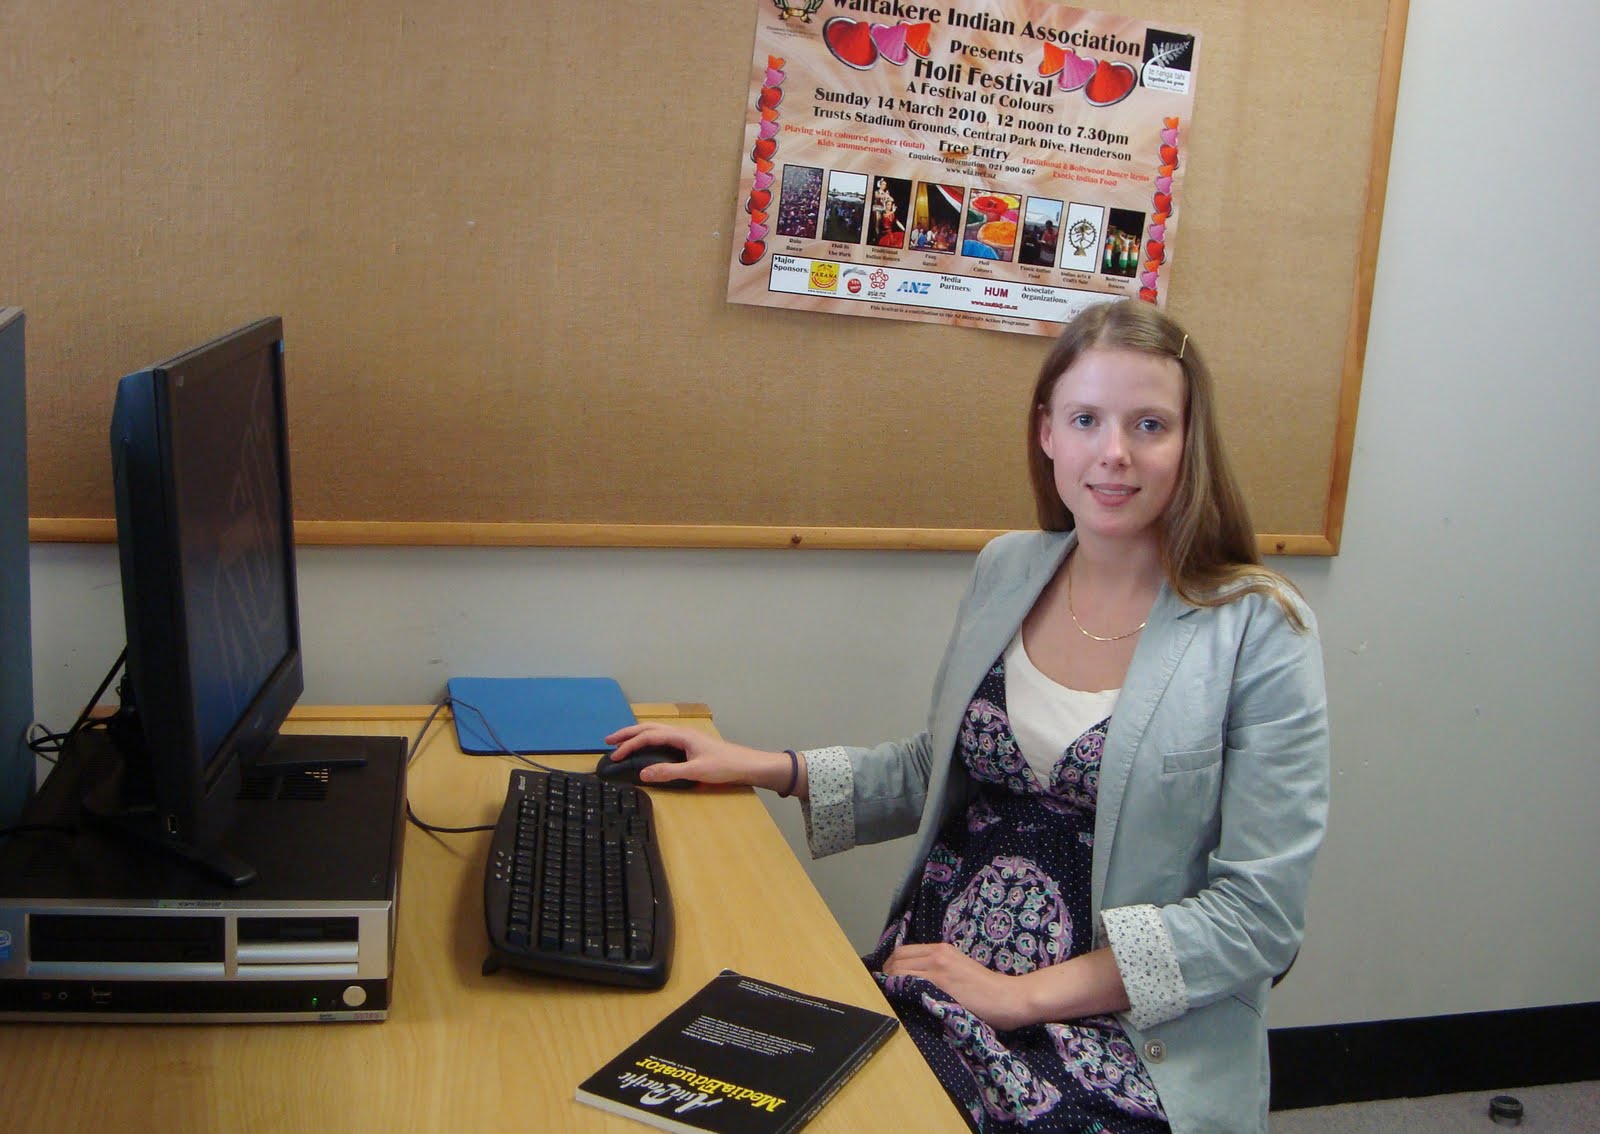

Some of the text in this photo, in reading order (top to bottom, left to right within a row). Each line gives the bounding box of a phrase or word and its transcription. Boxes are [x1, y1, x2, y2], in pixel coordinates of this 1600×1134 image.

[948, 8, 1015, 35] Indian
[1020, 21, 1140, 57] Association
[950, 40, 1024, 64] Presents
[914, 59, 1053, 97] Holi Festival
[906, 81, 1054, 114] A Festival of Colours
[814, 88, 1129, 146] Sunday 14 March 2010, 12 noon to 7.30pm
[784, 124, 814, 136] Playing
[816, 129, 832, 138] with
[834, 132, 868, 142] coloured
[870, 136, 897, 146] powder
[813, 106, 1132, 162] Trusts Stadium Grounds, Central Park Dive, Henderson
[818, 138, 835, 148] Kids
[938, 140, 1010, 162] Free Entry
[1004, 165, 1020, 174] 900
[1022, 156, 1061, 169] Traditional
[1070, 164, 1104, 176] Bollywood
[1106, 169, 1128, 179] Dance
[1130, 172, 1150, 182] Items
[1052, 170, 1118, 187] Exotic Indian Food
[774, 256, 794, 264] Major
[896, 281, 931, 294] ANZ
[940, 276, 962, 284] Media
[984, 286, 1008, 298] HUM
[1023, 286, 1055, 294] Associate
[1002, 319, 1030, 327] Programme
